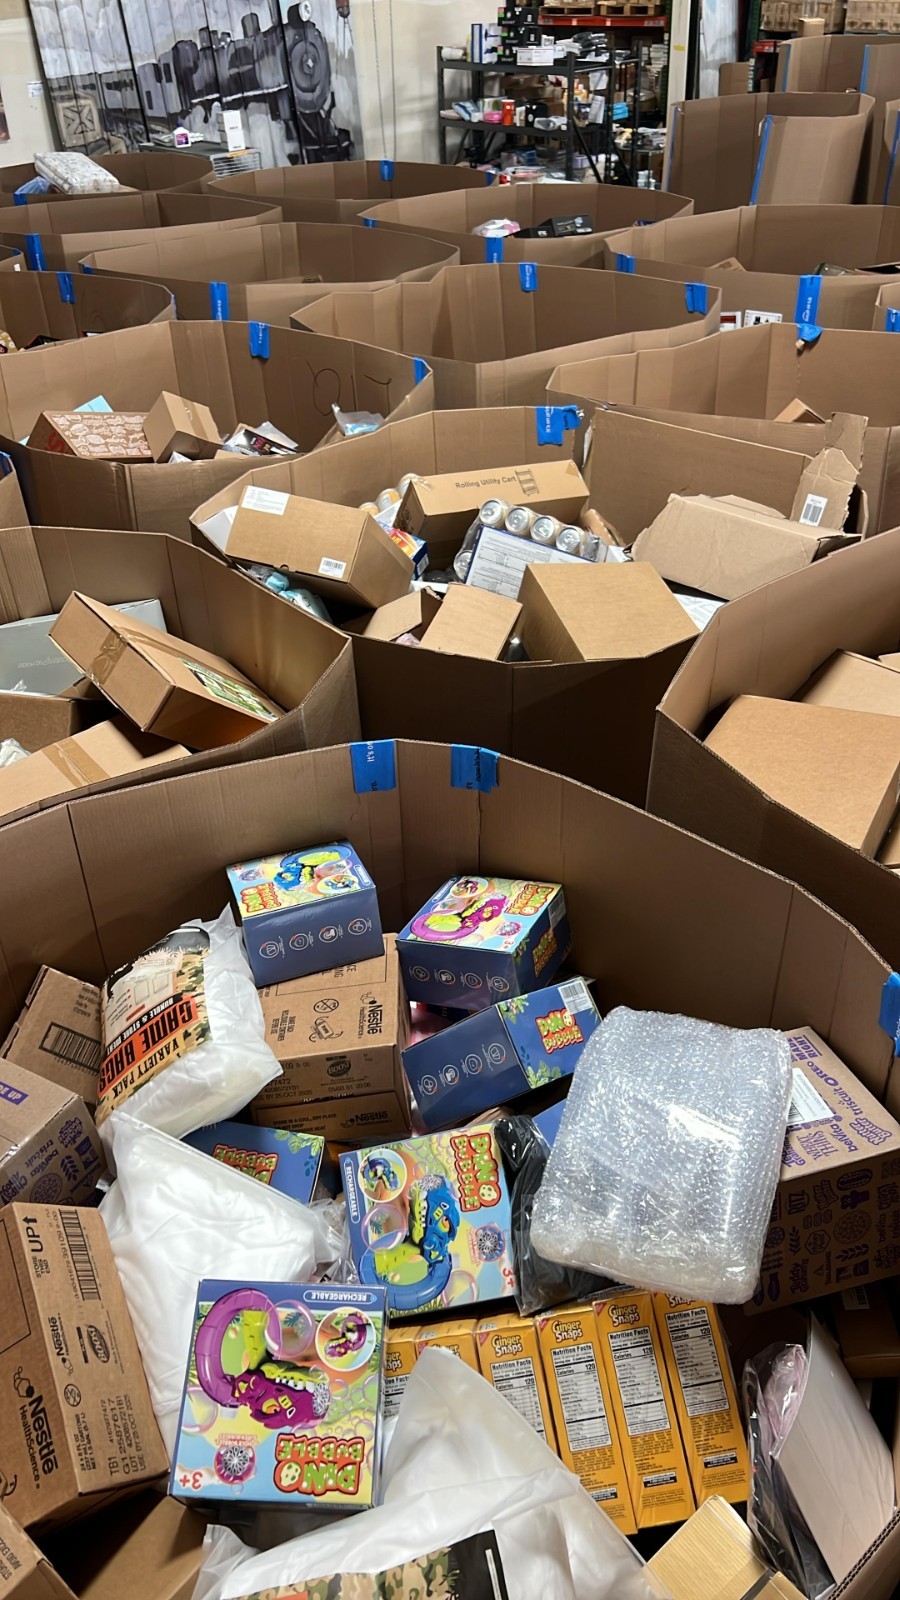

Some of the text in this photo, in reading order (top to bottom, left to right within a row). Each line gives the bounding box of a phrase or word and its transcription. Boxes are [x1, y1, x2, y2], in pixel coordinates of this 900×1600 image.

[455, 475, 516, 489] Rolling Utility Cart
[366, 750, 375, 763] It's
[138, 1000, 194, 1053] GAME
[537, 1011, 574, 1036] DINO
[543, 1025, 582, 1052] BUBBLE
[793, 1036, 818, 1058] RIGHT
[98, 1040, 137, 1094] BAGS
[136, 1038, 181, 1081] VARIETY
[807, 1060, 839, 1087] OREO
[7, 1090, 22, 1100] UP
[111, 1074, 136, 1099] PACK
[833, 1086, 863, 1116] triscuit
[796, 1135, 824, 1160] WHEAT
[808, 1130, 839, 1157] THINS
[830, 1122, 859, 1153] belVita
[25, 1139, 54, 1169] triscuit
[30, 1149, 59, 1177] belVita
[215, 1147, 277, 1170] BUBBLE
[452, 1135, 479, 1212] BUBBLE
[468, 1133, 502, 1206] DINO
[344, 1165, 359, 1218] RECHARGEABLE
[787, 1190, 808, 1215] RITZ
[25, 1226, 43, 1253] UP
[31, 1255, 41, 1278] STORE
[502, 1265, 517, 1291] 3+
[788, 1263, 803, 1294] Teddy
[310, 1291, 370, 1303] RECHARGEABLE
[608, 1303, 638, 1317] Ginger
[612, 1312, 640, 1327] Snaps
[667, 1312, 690, 1322] Nutrition
[690, 1308, 706, 1317] Facts
[551, 1320, 580, 1334] Ginger
[555, 1328, 583, 1342] Snaps
[609, 1328, 649, 1340] Nutrition Facts
[671, 1333, 690, 1341] Calories
[700, 1327, 711, 1335] 120
[87, 1325, 107, 1361] BOOST
[491, 1335, 521, 1348] Ginger
[495, 1342, 523, 1357] Snaps
[552, 1344, 592, 1357] Nutrition Facts
[642, 1346, 653, 1355] 120
[492, 1359, 532, 1371] Nutrition Facts
[585, 1363, 596, 1371] 120
[495, 1383, 514, 1391] Calories
[524, 1377, 534, 1386] 120
[128, 1413, 137, 1430] OCT
[19, 1404, 40, 1477] HealthScience
[107, 1397, 130, 1474] G1 2587617
[134, 1441, 142, 1452] BY
[278, 1437, 364, 1463] BUBBLE
[108, 1456, 120, 1476] TB1
[129, 1456, 139, 1473] LOT
[137, 1454, 146, 1472] USE
[179, 1470, 204, 1491] 3+
[278, 1458, 360, 1495] DINO
